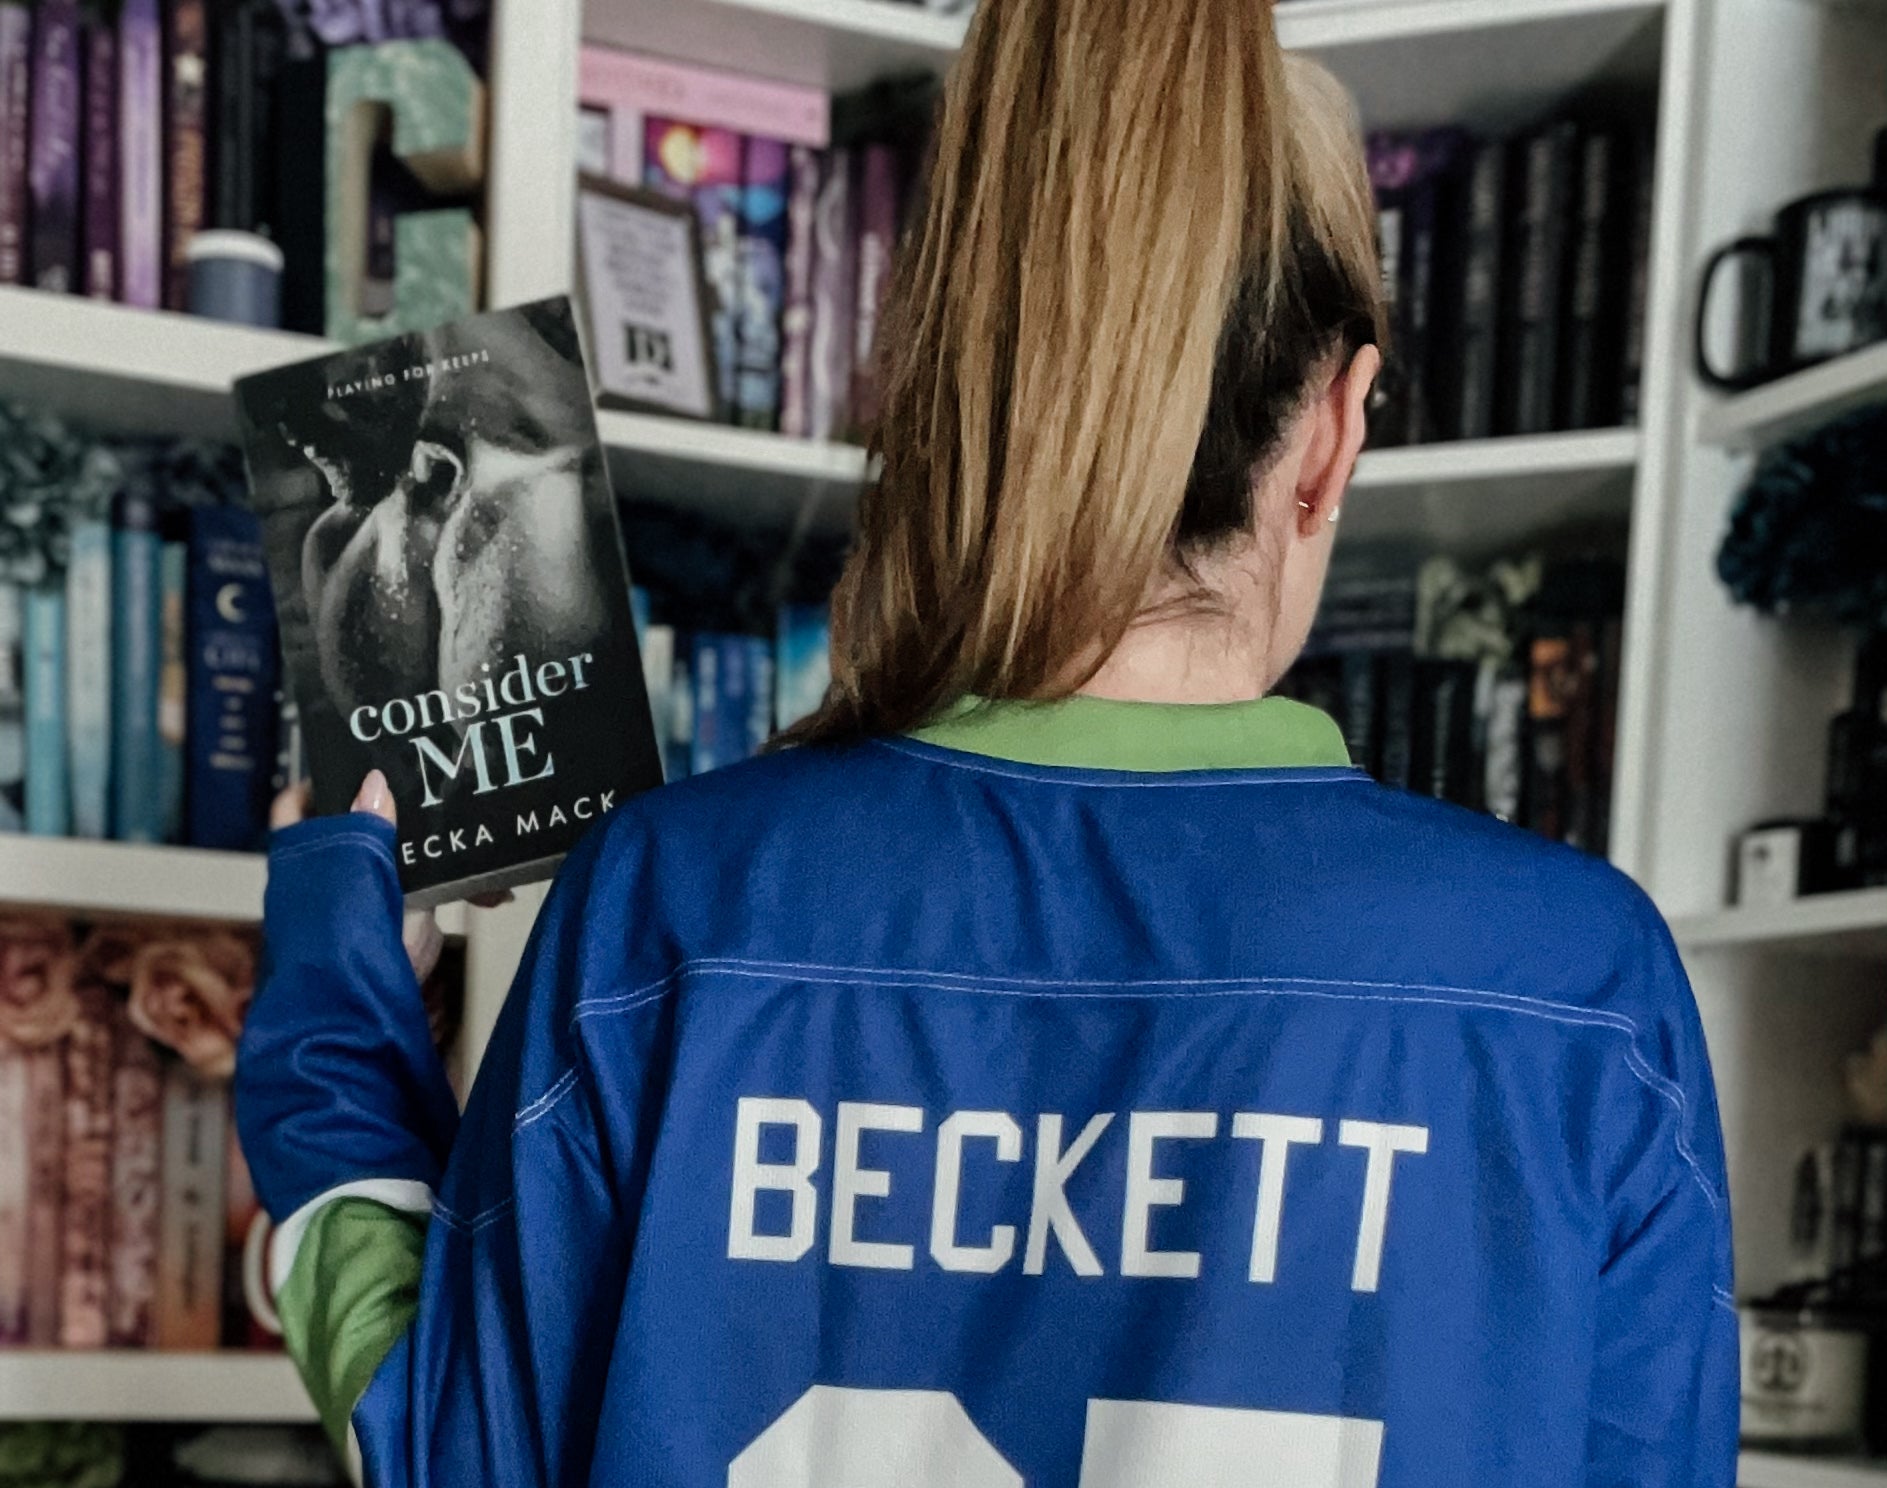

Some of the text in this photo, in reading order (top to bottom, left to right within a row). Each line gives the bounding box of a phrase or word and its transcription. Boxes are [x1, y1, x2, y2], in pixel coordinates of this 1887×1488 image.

[327, 349, 489, 400] PLAYING FOR KEEPS
[350, 653, 593, 742] consider
[409, 707, 555, 807] ME
[401, 790, 615, 865] ECKA MACK
[728, 1097, 1429, 1292] BECKETT
